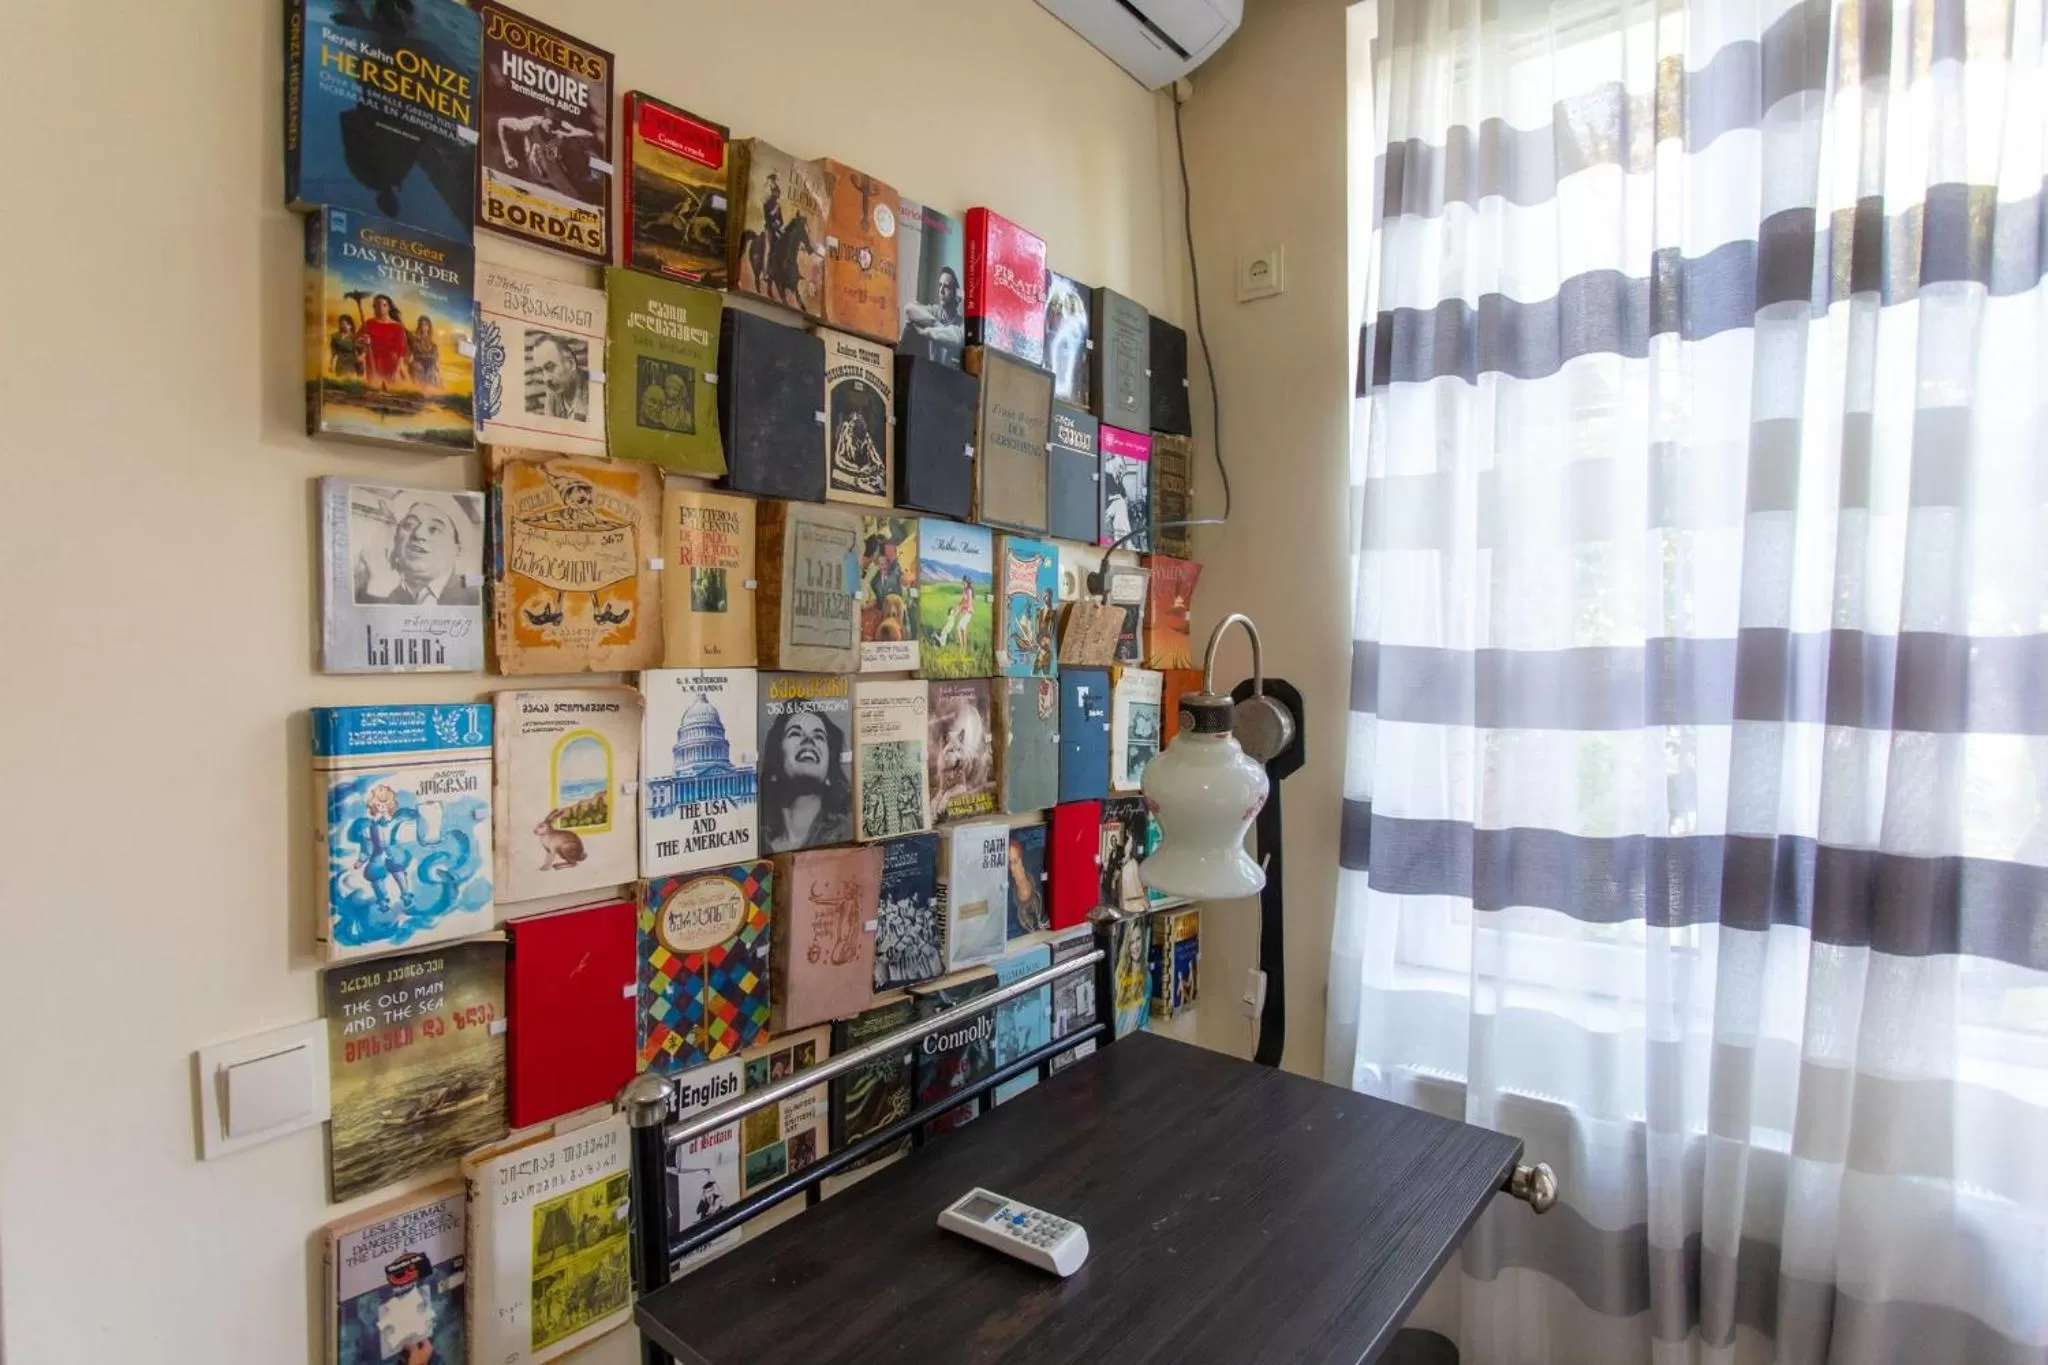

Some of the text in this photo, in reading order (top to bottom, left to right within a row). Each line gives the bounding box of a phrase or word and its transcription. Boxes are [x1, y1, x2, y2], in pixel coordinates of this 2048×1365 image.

[321, 27, 394, 65] René Kahn
[487, 14, 604, 83] JOKERS
[320, 43, 471, 126] HERSENEN
[395, 48, 471, 100] ONZE
[501, 50, 589, 108] HISTOIRE
[383, 106, 398, 118] EN
[510, 80, 581, 116] Terminales ABCD
[488, 196, 601, 249] BORDAS
[342, 241, 461, 285] DAS VOLK DER
[359, 227, 446, 263] Gear & Gear
[376, 263, 430, 289] STILLE
[786, 702, 794, 715] &
[678, 800, 729, 819] THE USA
[692, 816, 717, 835] AND
[656, 828, 750, 858] THE AMERICANS
[343, 980, 444, 1018] THE OLD MAN
[343, 997, 444, 1037] AND THE SEA
[344, 1001, 496, 1064] მოხუცი და ზღვა
[923, 1015, 995, 1055] Connolly
[681, 1071, 738, 1109] English
[701, 1127, 733, 1150] Britain
[361, 1202, 447, 1240] LESLIE THOMAS
[346, 1221, 461, 1269] THE LAST DETECTIVE
